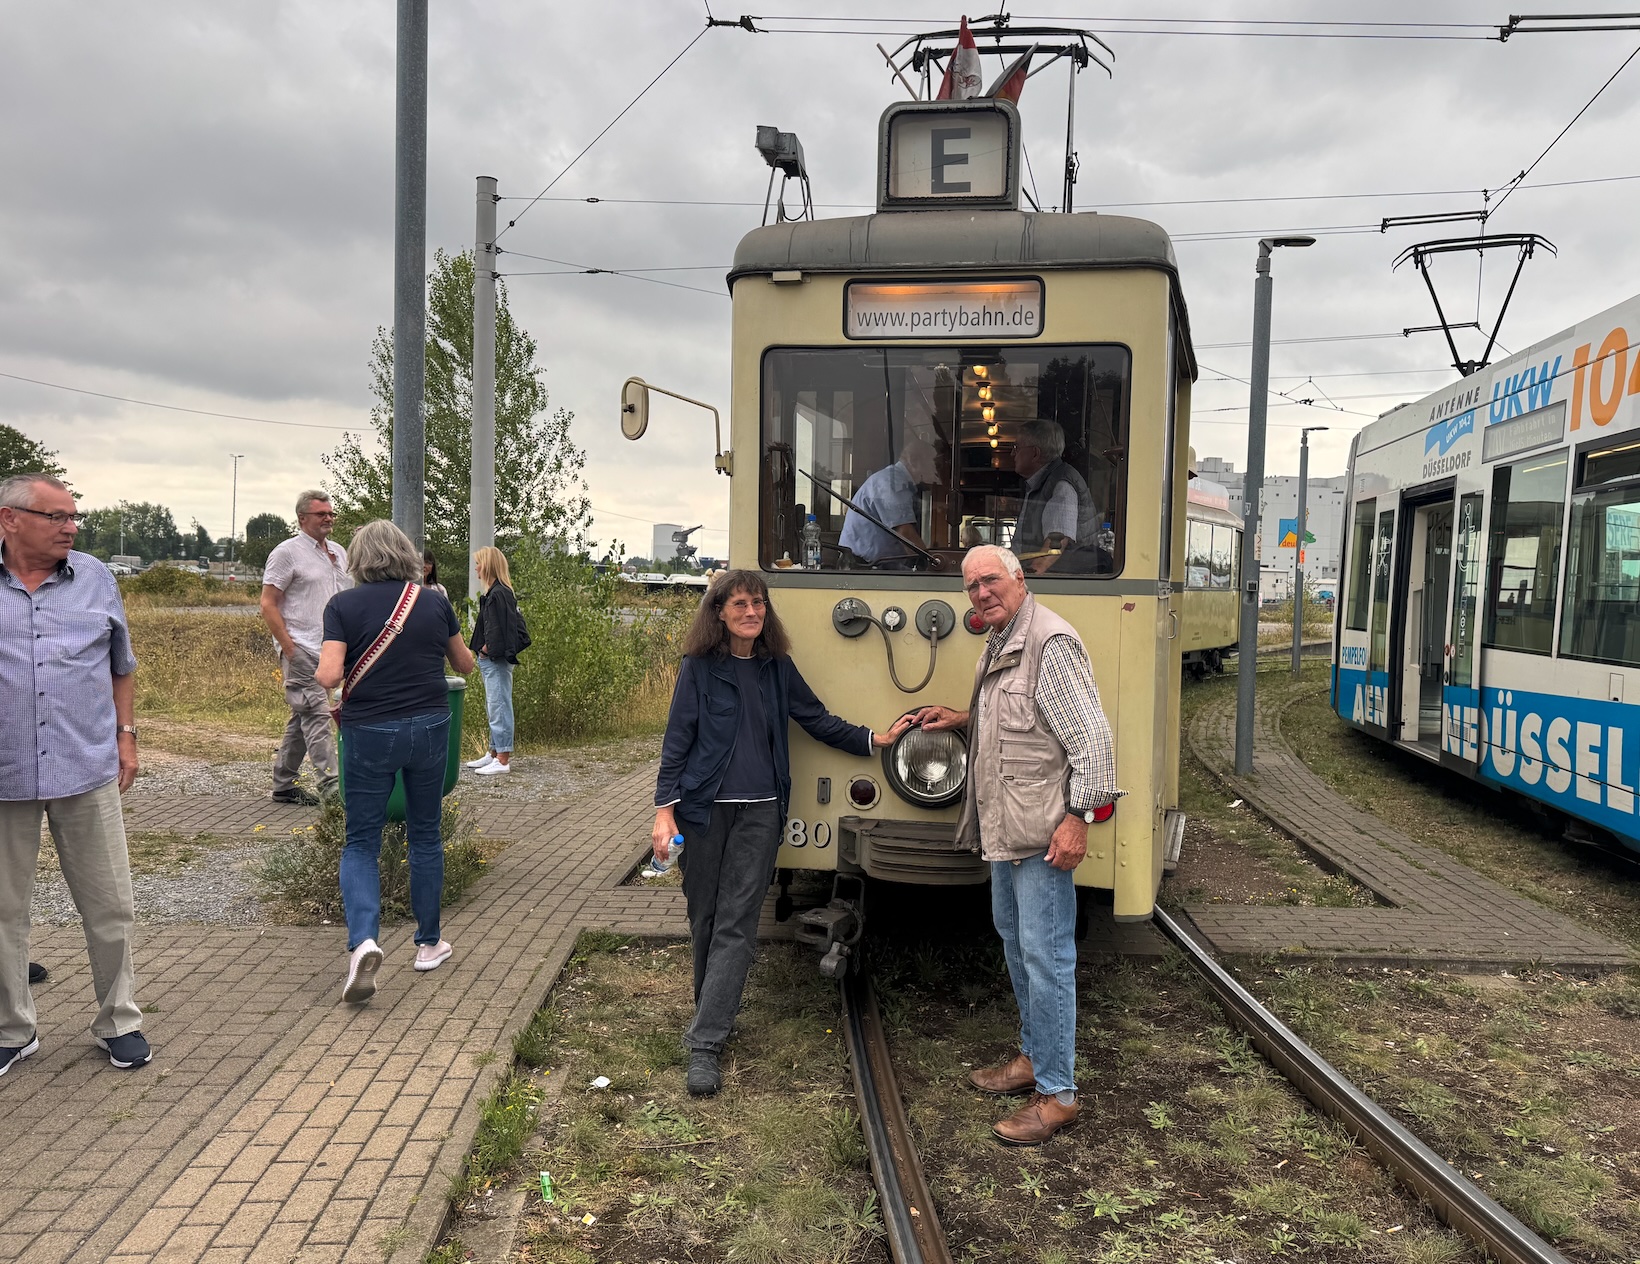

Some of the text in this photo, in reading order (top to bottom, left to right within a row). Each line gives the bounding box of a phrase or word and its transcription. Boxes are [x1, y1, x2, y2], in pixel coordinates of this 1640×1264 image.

[931, 127, 971, 194] E
[856, 305, 1035, 332] www.partybahn.de
[1429, 386, 1480, 422] ANTENNE
[1489, 355, 1562, 425] UKW
[1446, 423, 1458, 443] UKW
[1423, 450, 1472, 479] DÜSSELDORF
[1281, 540, 1296, 548] deu
[1342, 646, 1368, 666] PEMPELFO
[787, 818, 832, 848] 80
